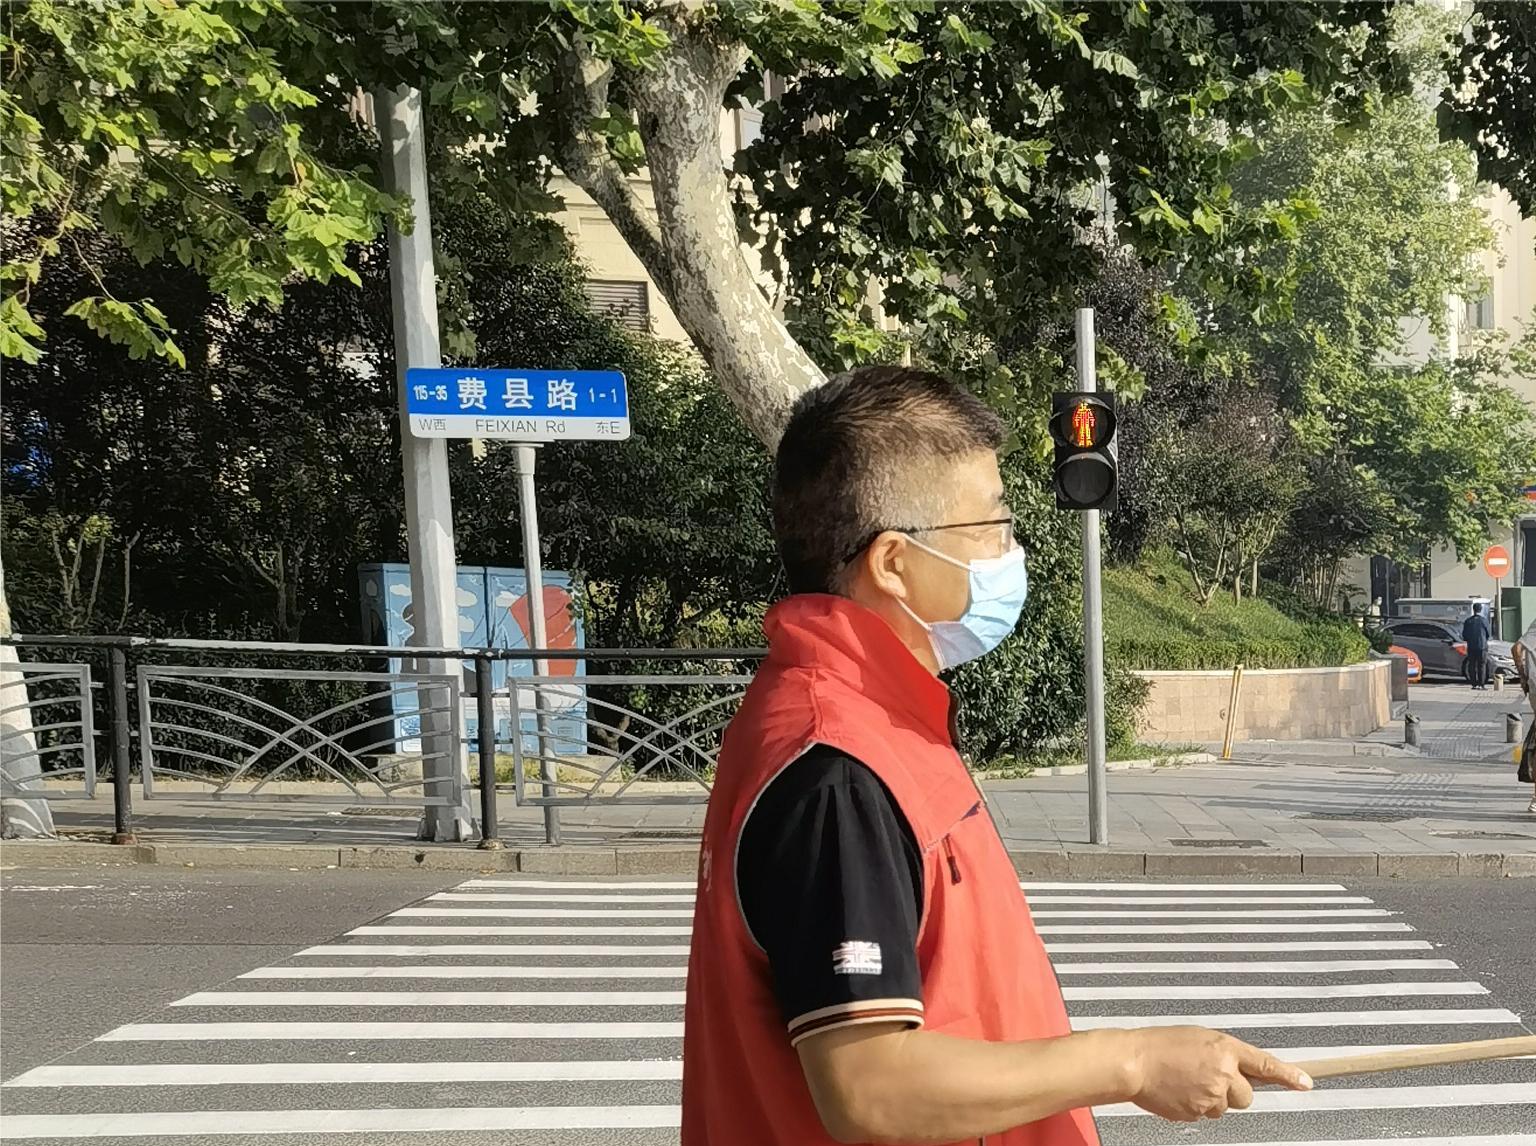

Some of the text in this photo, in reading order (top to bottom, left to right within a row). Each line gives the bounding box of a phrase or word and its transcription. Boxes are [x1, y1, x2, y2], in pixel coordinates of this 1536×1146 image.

[457, 376, 578, 411] 费县路
[475, 419, 538, 433] FEIXIAN
[546, 420, 566, 433] Rd
